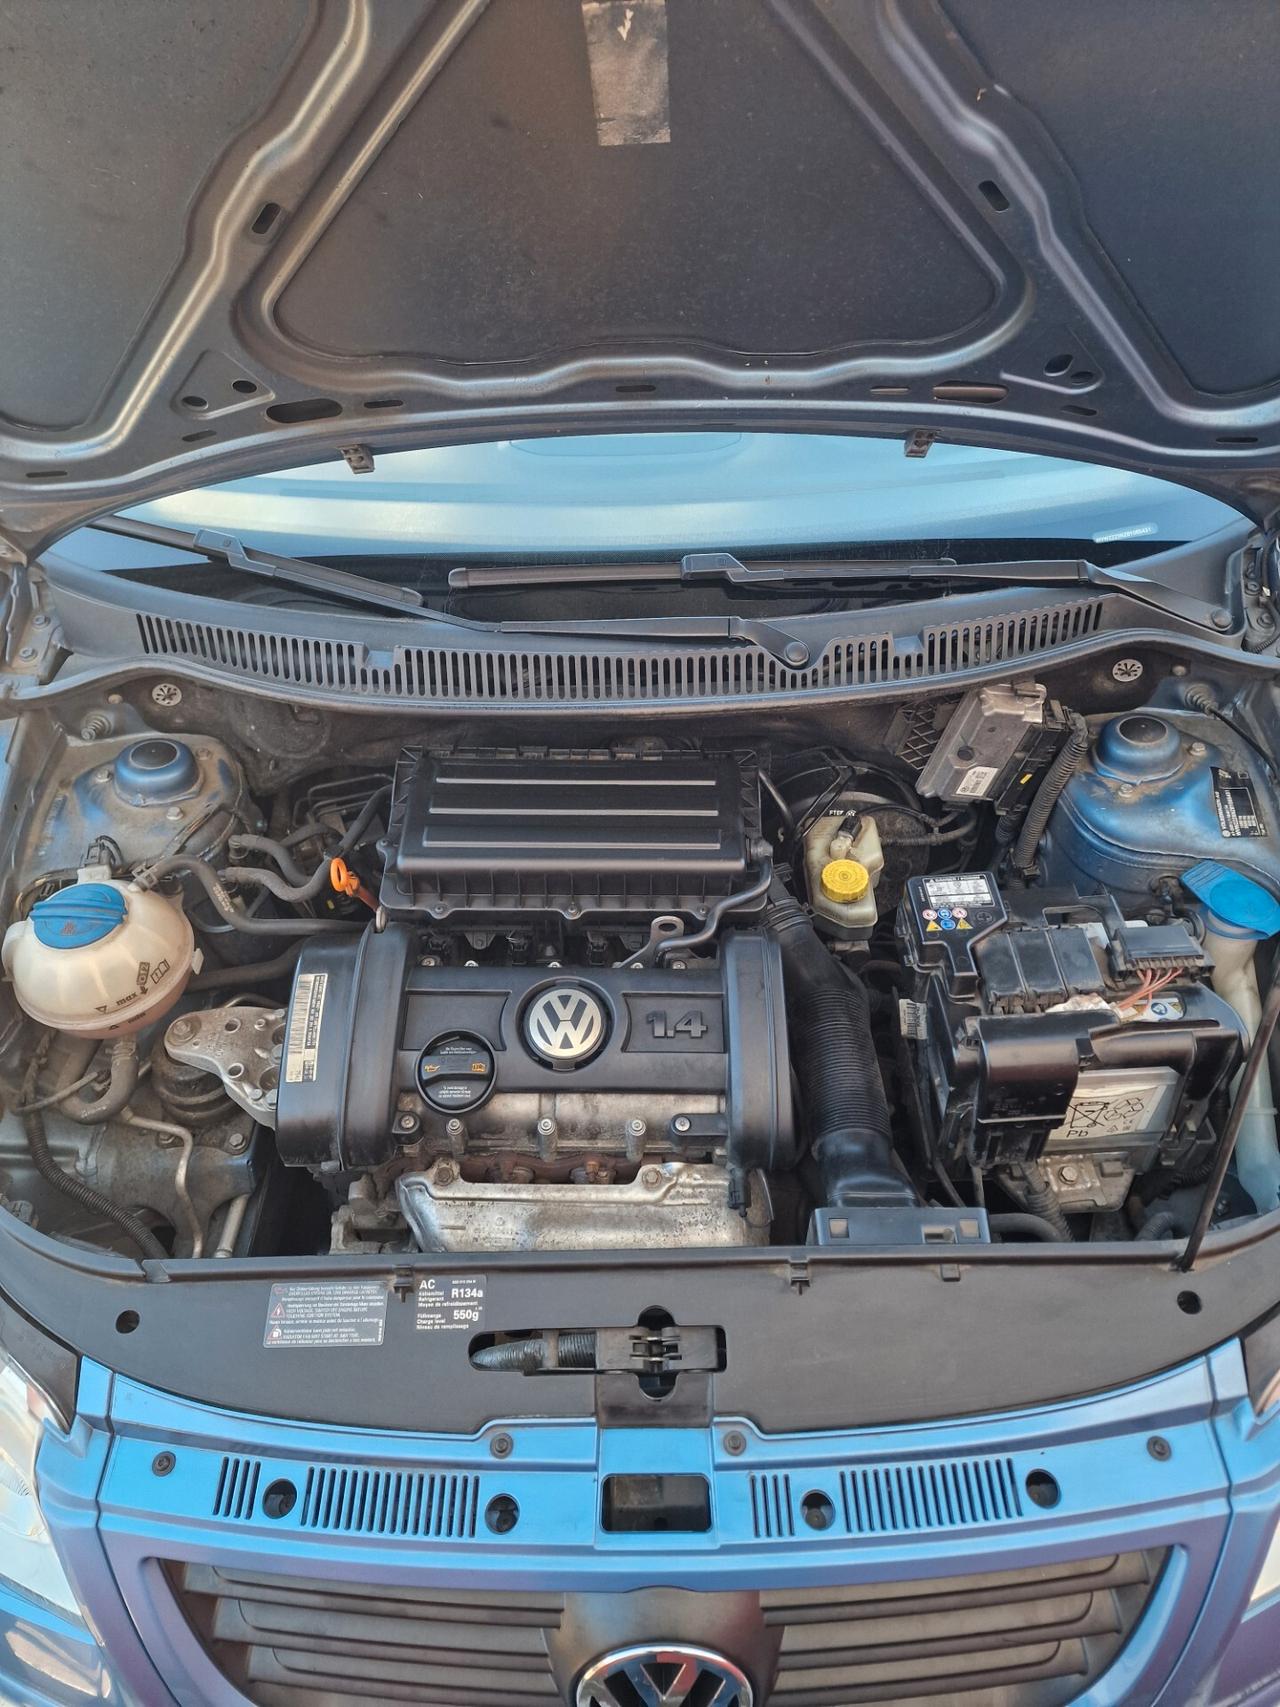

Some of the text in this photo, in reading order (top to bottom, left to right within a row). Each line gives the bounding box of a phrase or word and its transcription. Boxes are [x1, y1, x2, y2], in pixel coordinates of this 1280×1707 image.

[116, 992, 138, 1006] max
[646, 1010, 708, 1039] 1.4
[1066, 1130, 1089, 1138] Pb
[419, 1279, 436, 1290] AC
[451, 1288, 483, 1299] R134a
[453, 1309, 479, 1321] 550g
